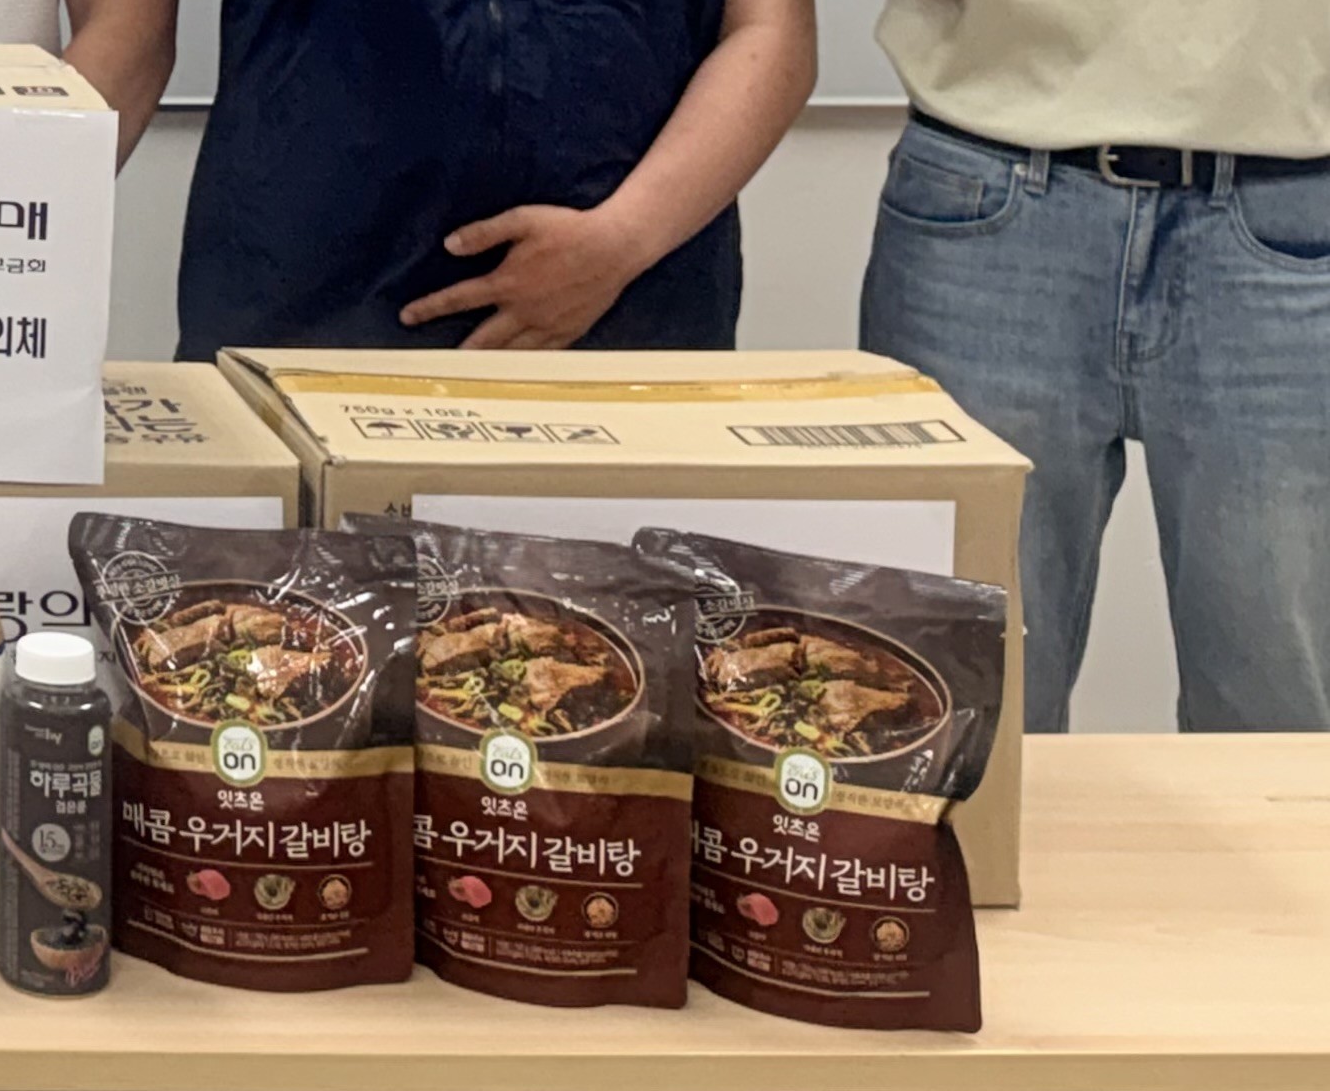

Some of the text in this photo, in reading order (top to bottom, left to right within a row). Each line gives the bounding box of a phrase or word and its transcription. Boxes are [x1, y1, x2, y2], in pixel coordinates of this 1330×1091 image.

[423, 407, 482, 418] 10EA
[224, 752, 256, 769] on
[491, 760, 523, 779] on
[30, 769, 103, 798] 하루곡물
[785, 778, 818, 800] on
[217, 789, 265, 812] 잇츠온
[481, 796, 528, 821] 잇츠온
[122, 801, 372, 859] 매콤 우거지 갈비탕
[773, 814, 821, 842] 잇츠온
[413, 814, 642, 878] 콤 우거지 갈비탕
[730, 837, 827, 891] 우거지
[830, 858, 935, 902] 갈비탕
